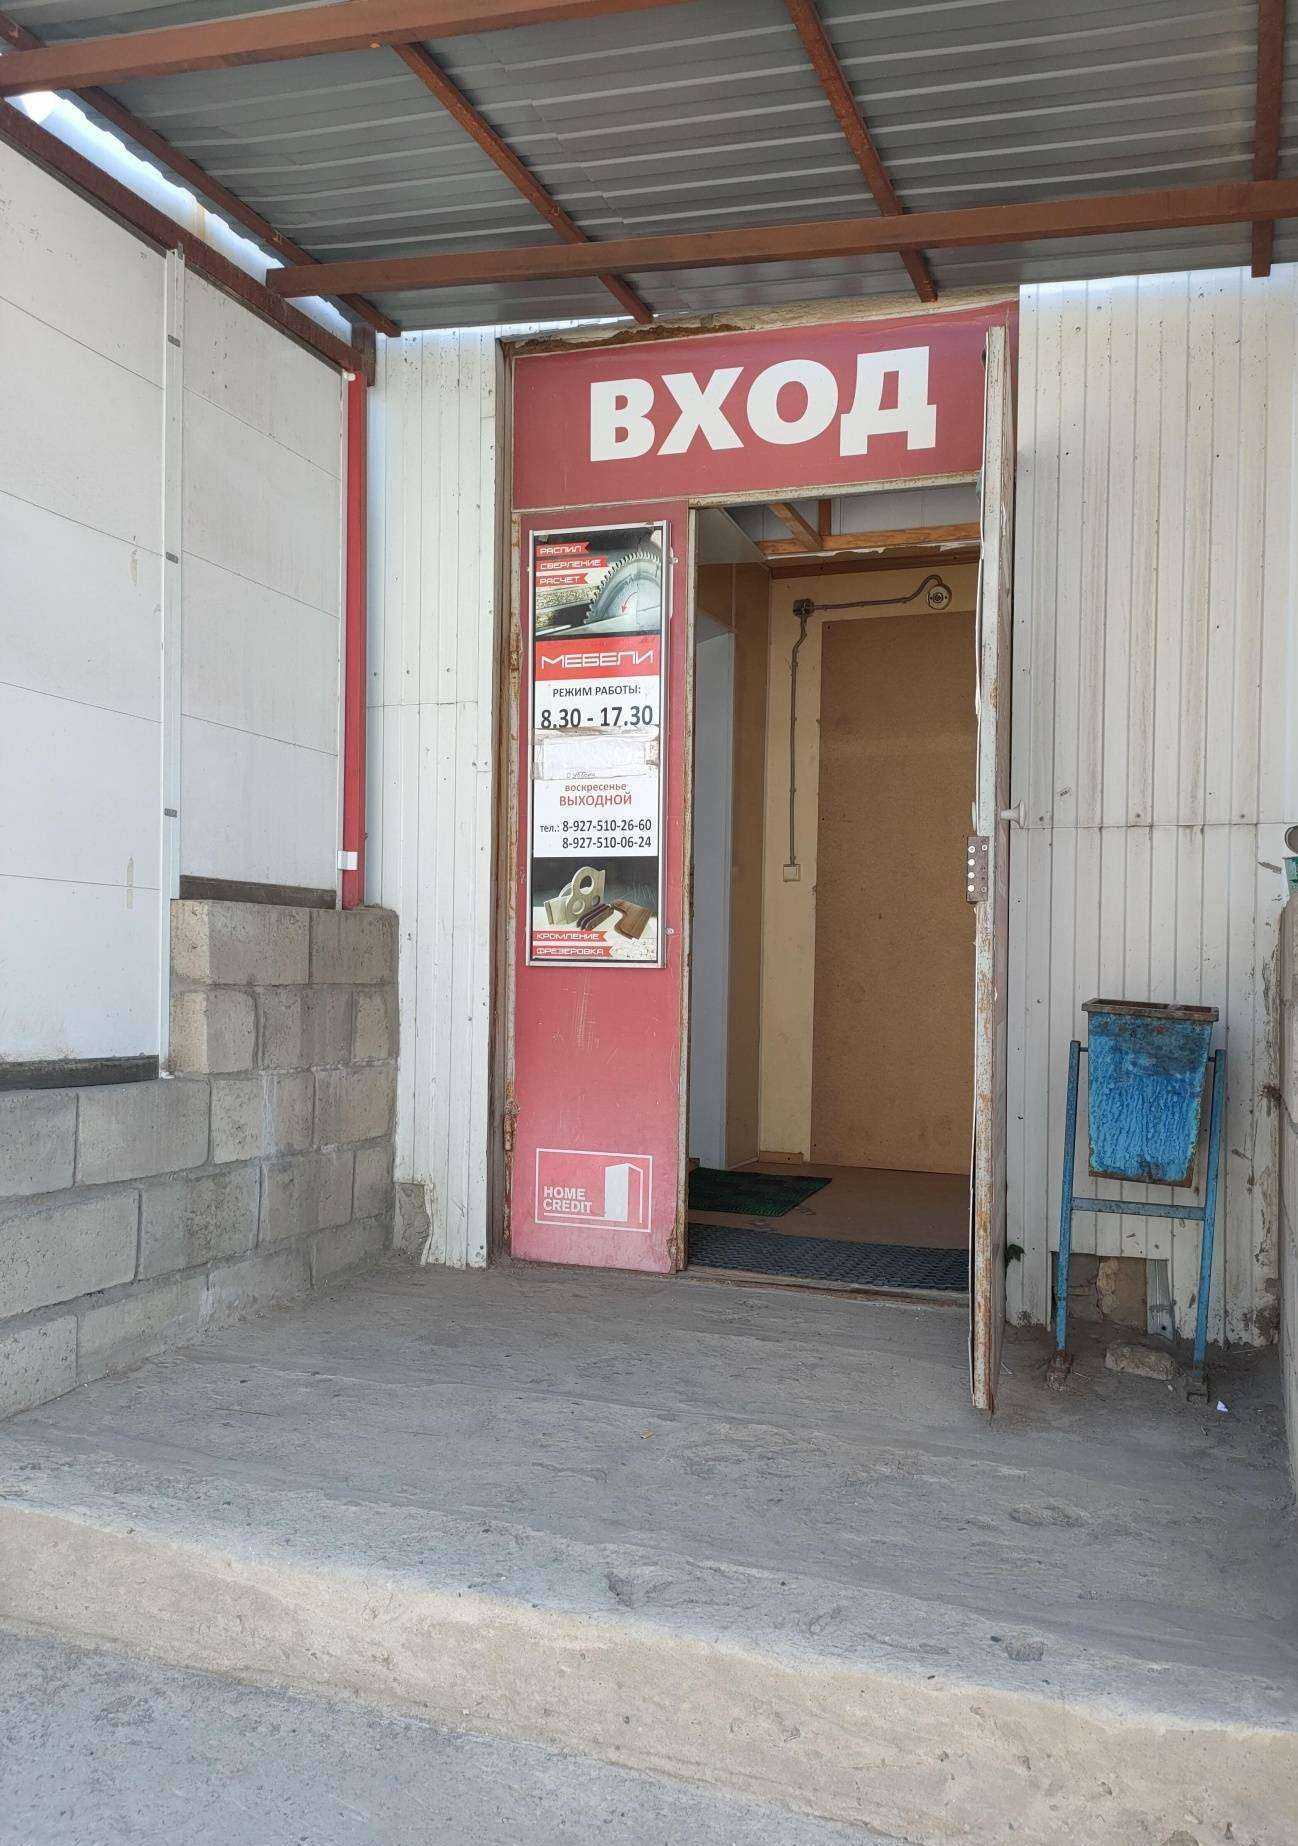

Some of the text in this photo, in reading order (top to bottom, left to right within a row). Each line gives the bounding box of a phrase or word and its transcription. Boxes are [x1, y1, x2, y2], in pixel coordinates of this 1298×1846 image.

[589, 345, 937, 462] ВХОД
[539, 545, 582, 555] РАСПИЛ
[540, 559, 601, 570] СВЕРЛЕНИЕ
[539, 575, 580, 585] РАСЧЕТ
[541, 650, 653, 669] МЕБЕЛИ
[552, 685, 641, 698] РЕЖИМ РАБОТЫ:
[540, 708, 582, 729] 8.30
[600, 705, 653, 727] 17.30
[565, 783, 627, 793] воскресенье
[560, 791, 632, 807] ВЫХОДНОЙ
[540, 818, 652, 833] тел.: 8-927-510-26-60
[562, 836, 652, 849] 8-927-510-06-24
[544, 1186, 586, 1200] HOME
[543, 1199, 592, 1213] CREDIT
